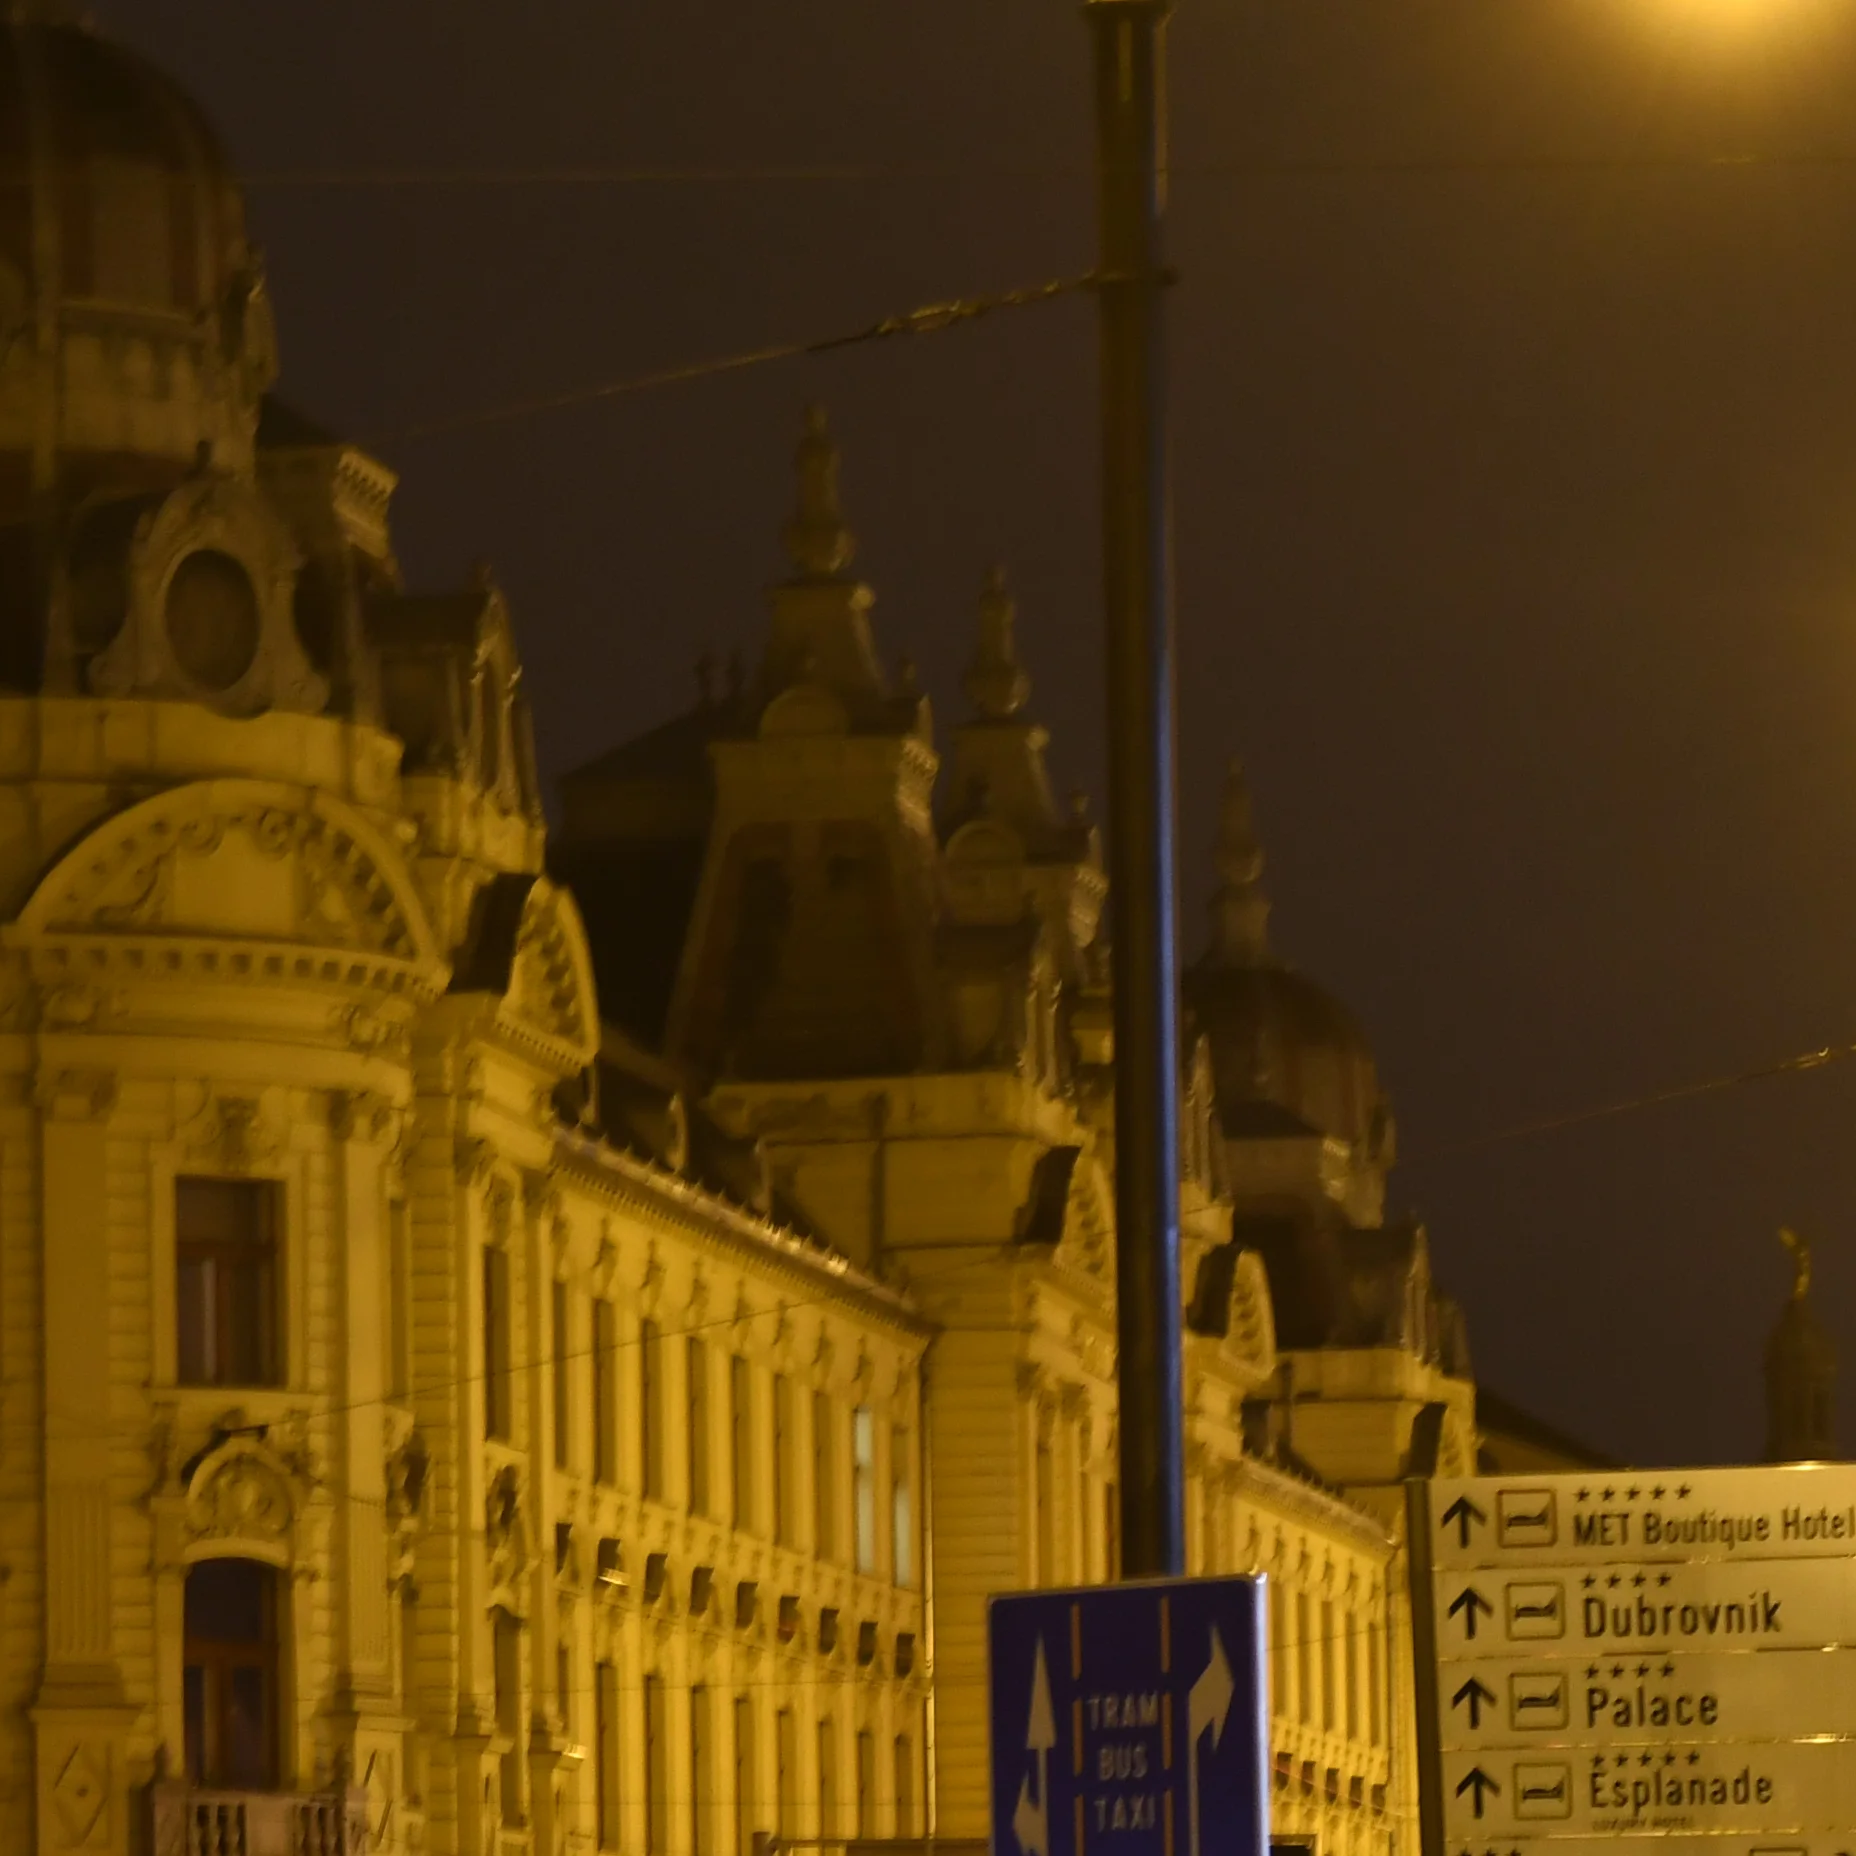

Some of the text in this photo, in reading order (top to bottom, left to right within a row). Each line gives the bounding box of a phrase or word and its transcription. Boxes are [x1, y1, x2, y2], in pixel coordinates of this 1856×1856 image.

[1572, 1504, 1856, 1551] MET Boutique Hotel
[1582, 1591, 1783, 1639] Dubrovnik
[1087, 1689, 1159, 1731] TRAM
[1586, 1687, 1719, 1729] Palace
[1098, 1744, 1149, 1781] BUS
[1589, 1764, 1774, 1817] Esplanade
[1093, 1795, 1157, 1832] TAXI
